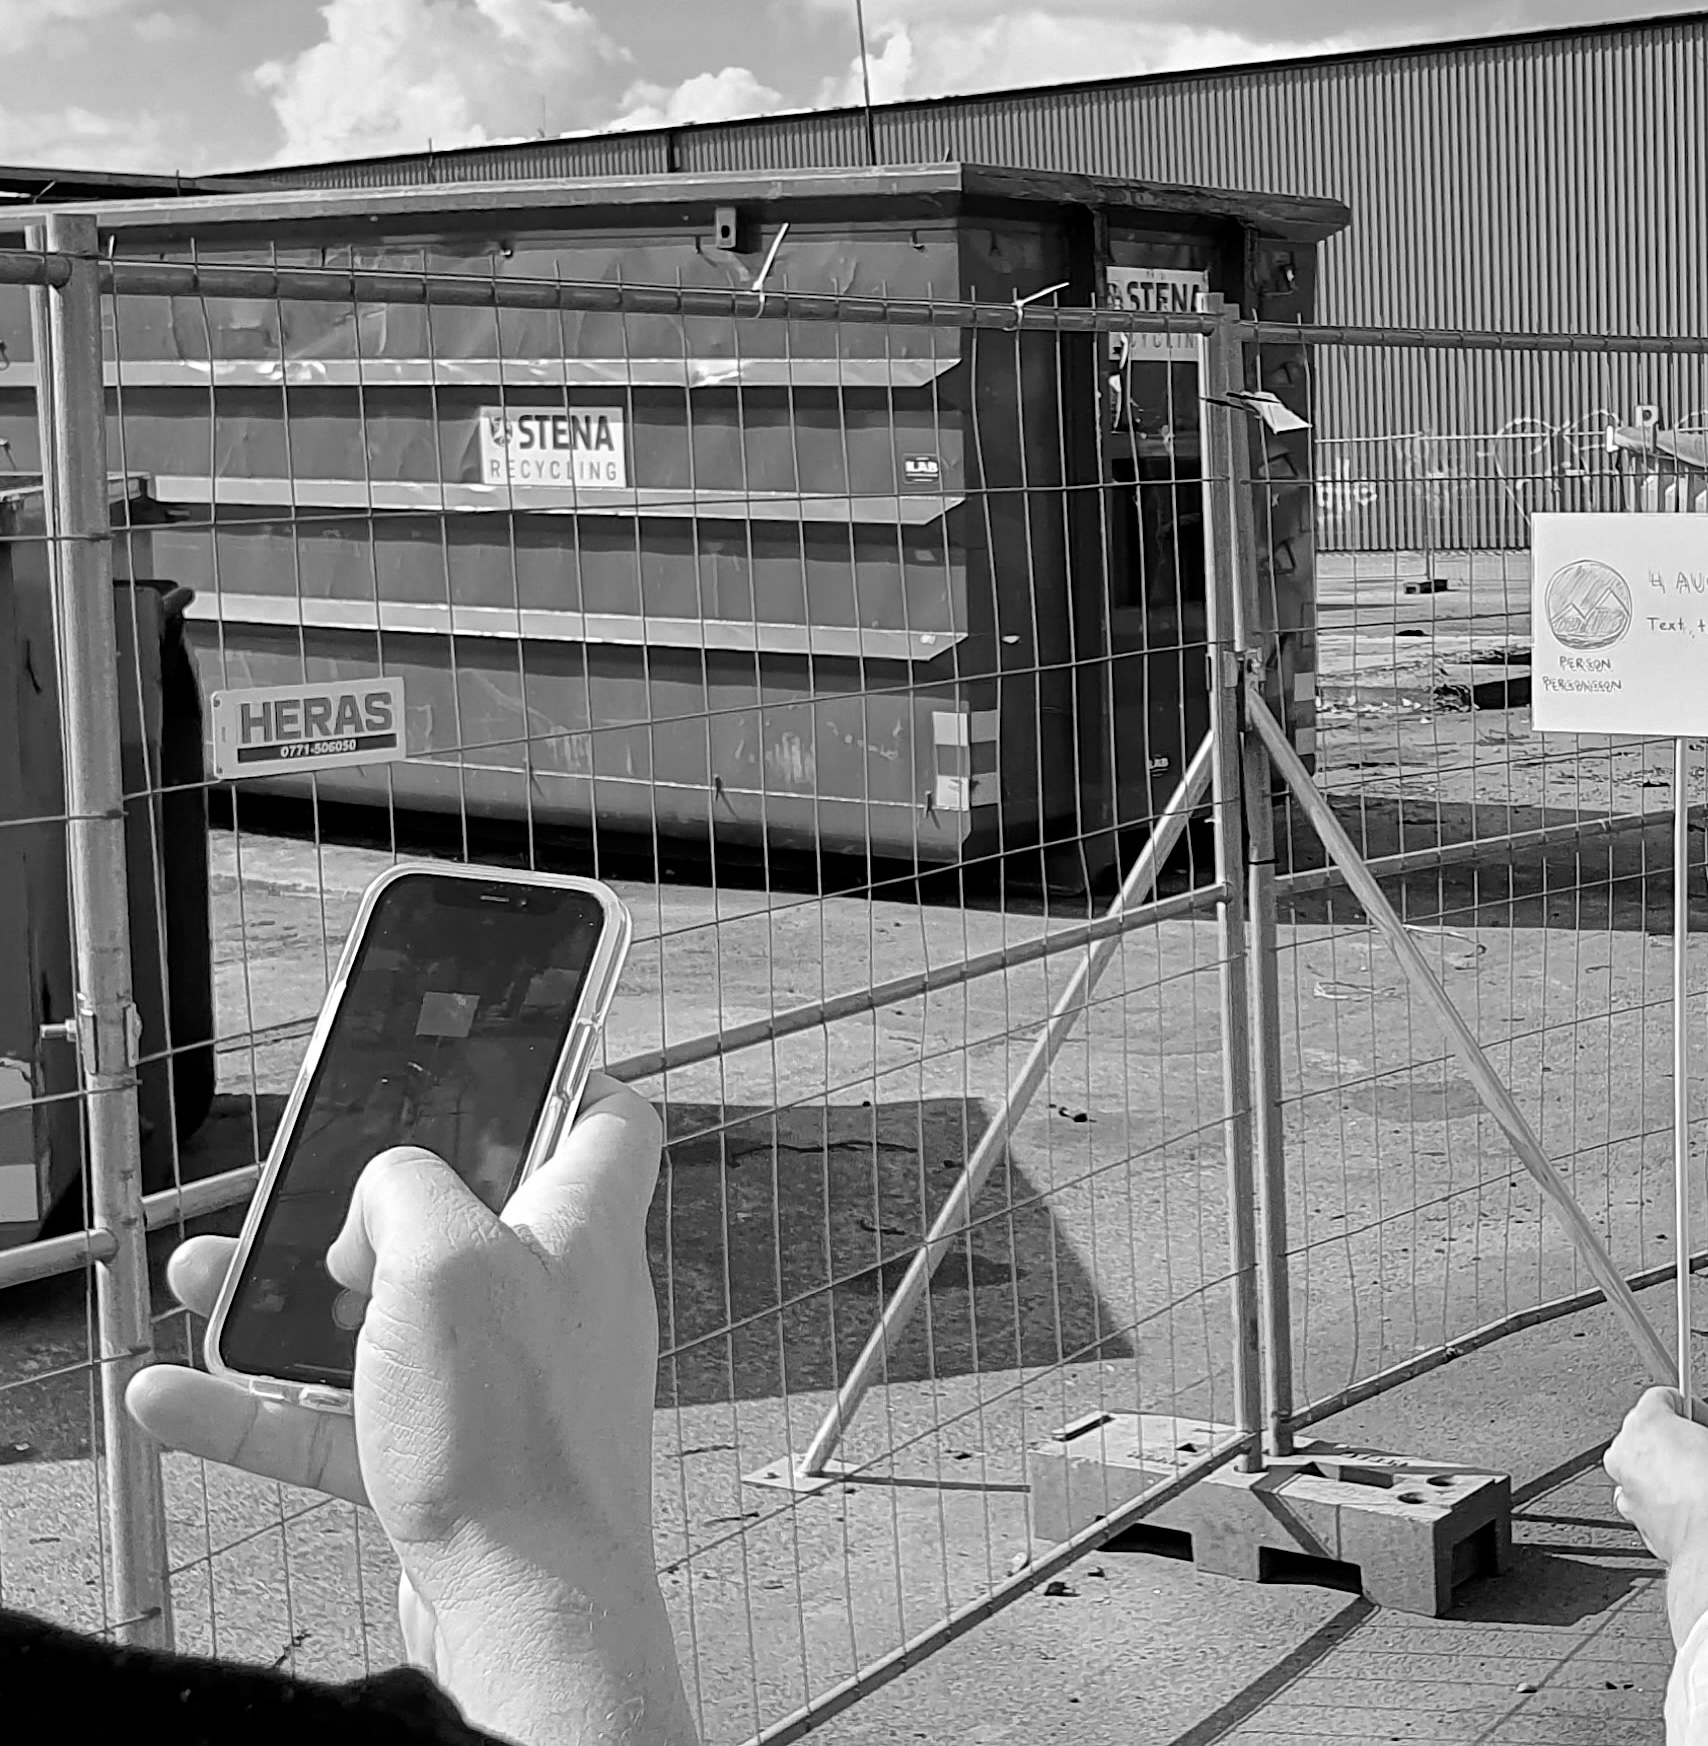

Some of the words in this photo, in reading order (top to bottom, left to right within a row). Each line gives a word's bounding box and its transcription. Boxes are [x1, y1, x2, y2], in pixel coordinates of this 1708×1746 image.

[518, 414, 615, 451] STENA
[490, 458, 617, 481] RECYCLING
[1648, 570, 1666, 594] 4
[1559, 655, 1613, 673] PERSON
[241, 691, 393, 744] HERAS
[280, 738, 357, 758] 0771-506050
